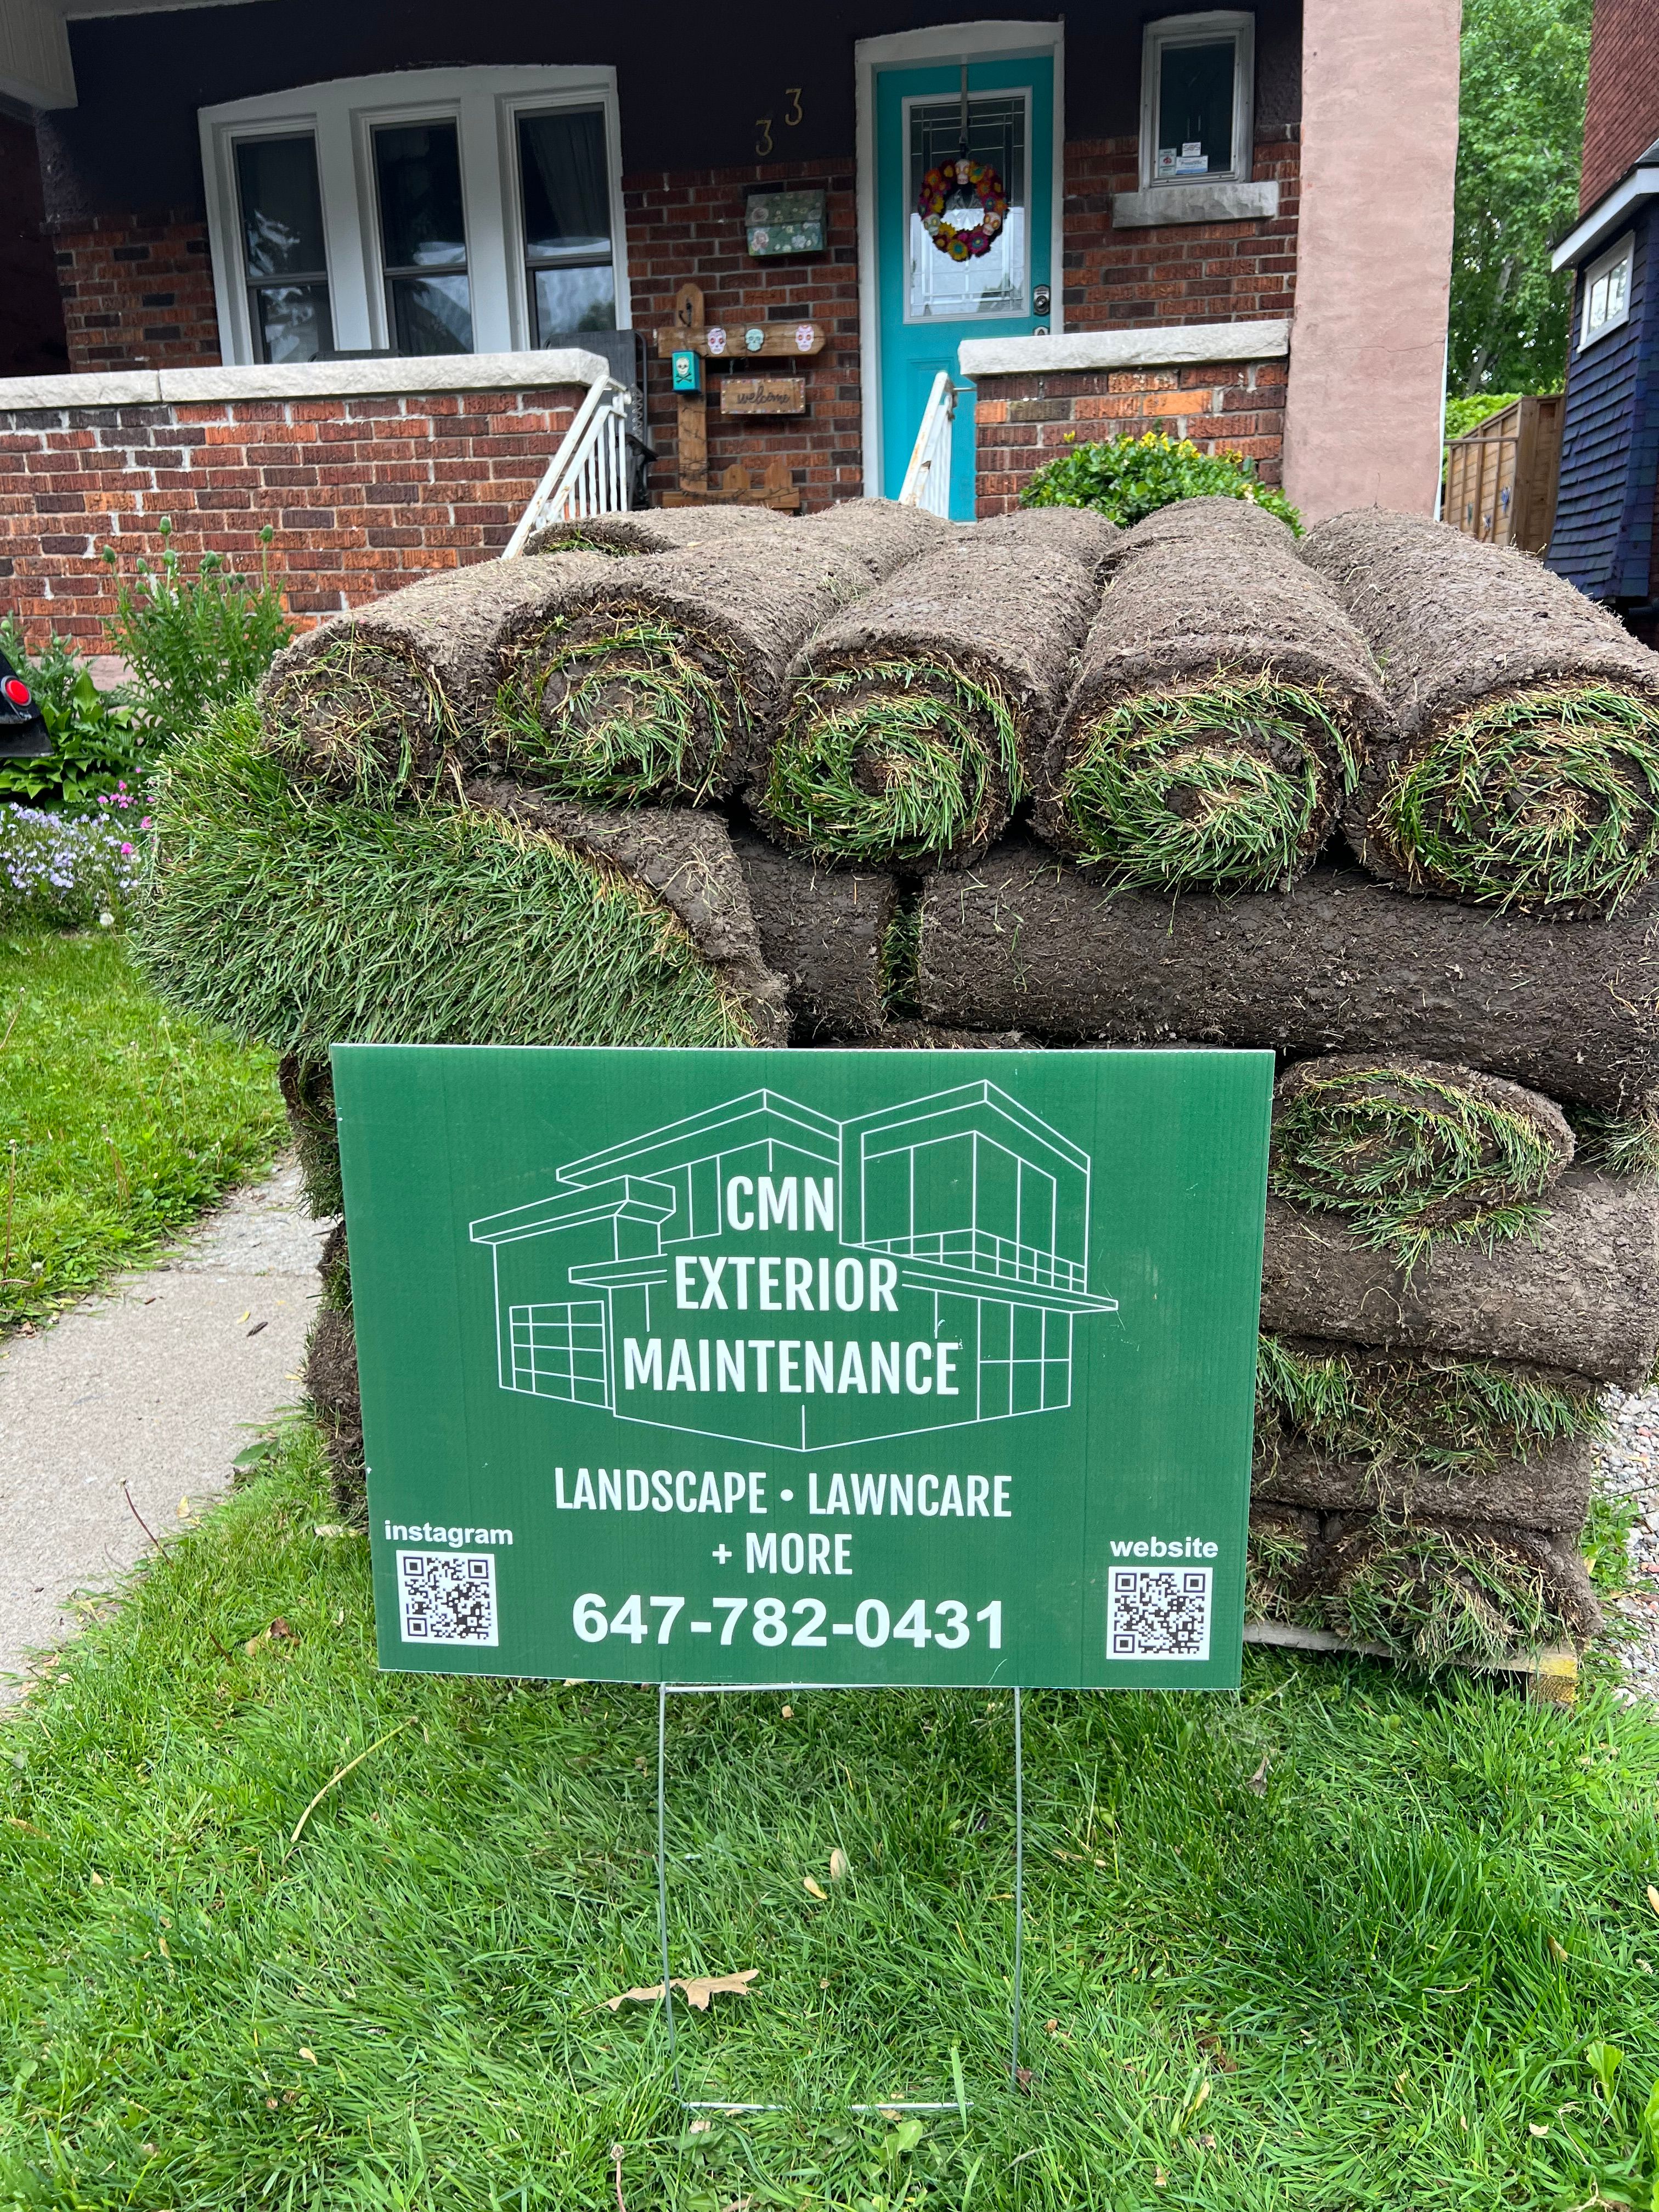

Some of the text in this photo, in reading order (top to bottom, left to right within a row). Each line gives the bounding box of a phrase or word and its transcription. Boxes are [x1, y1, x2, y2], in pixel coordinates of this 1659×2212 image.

[737, 386, 790, 404] welcome
[725, 1175, 835, 1233] CMN
[675, 1256, 900, 1313] EXTERIOR
[623, 1337, 960, 1397] MAINTENANCE
[554, 1466, 768, 1515] LANDSCAPE
[808, 1471, 1013, 1518] LAWNCARE
[383, 1519, 514, 1549] instagram
[744, 1531, 854, 1576] MORE
[1109, 1536, 1219, 1559] website
[572, 1592, 1003, 1650] 647-782-0431
